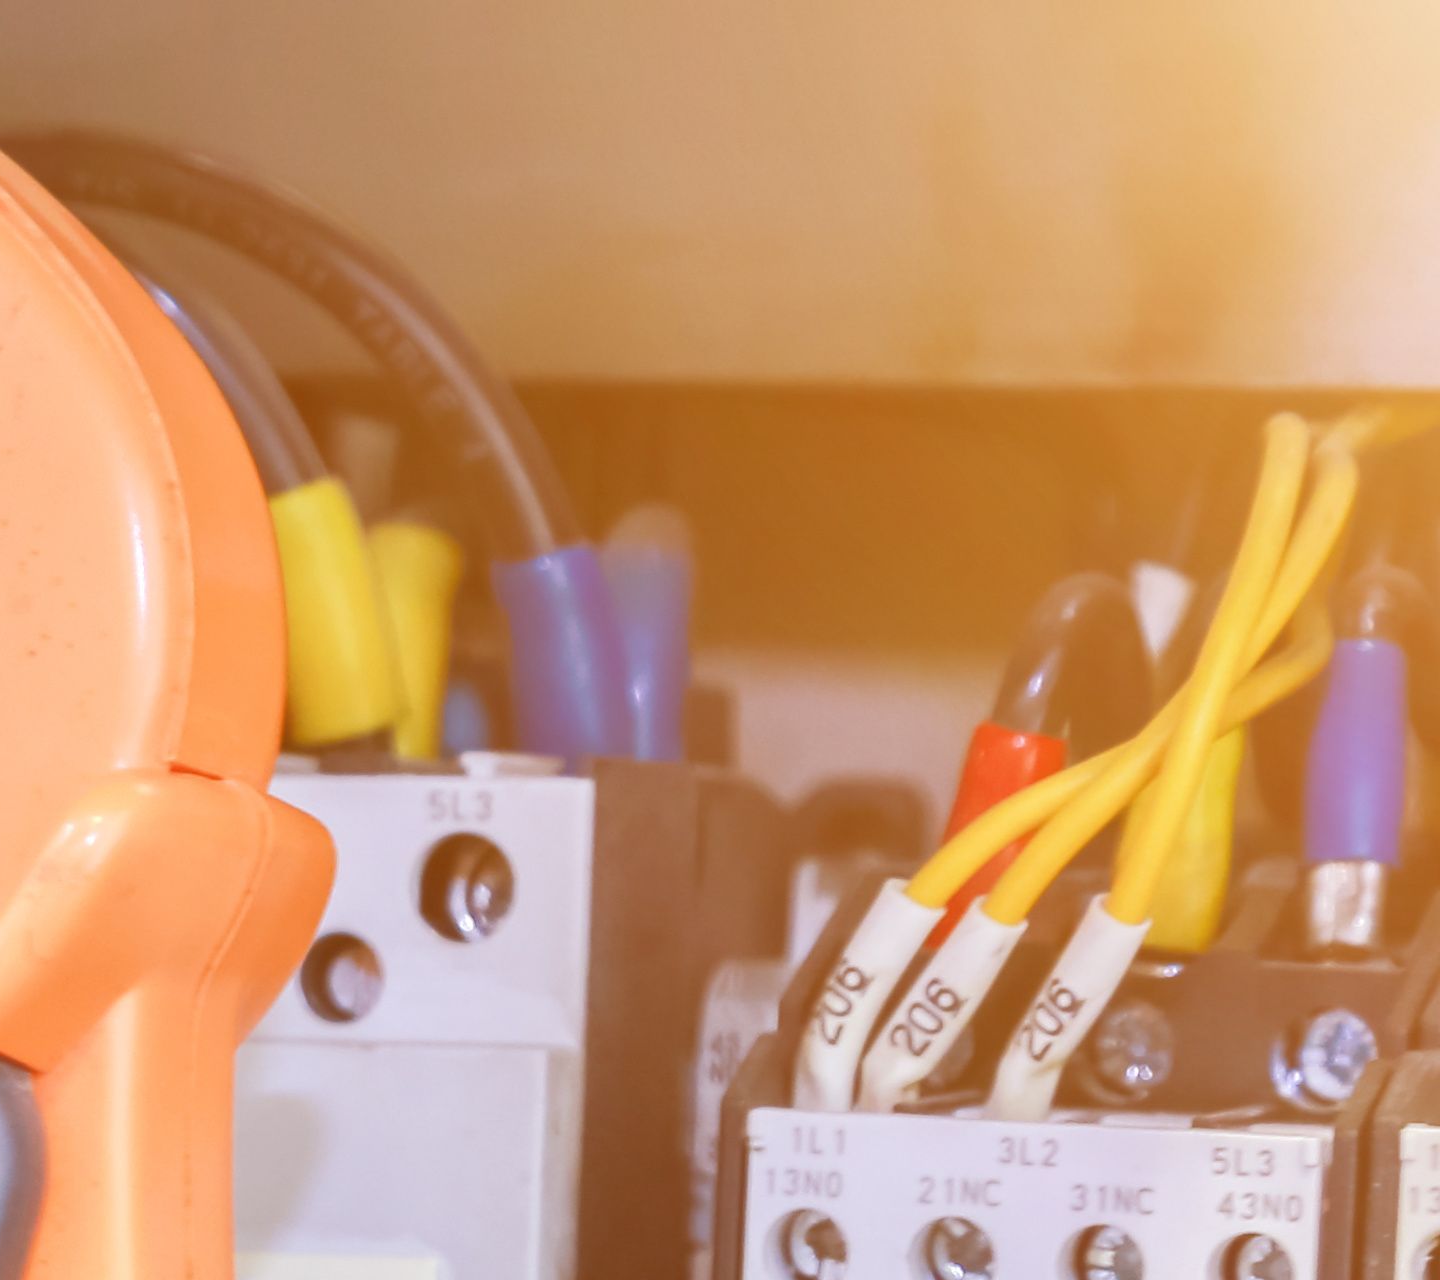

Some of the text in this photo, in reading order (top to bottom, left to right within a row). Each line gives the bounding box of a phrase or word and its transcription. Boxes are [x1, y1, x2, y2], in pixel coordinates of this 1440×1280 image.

[425, 788, 494, 822] 5L3
[890, 976, 963, 1059] 206
[1019, 978, 1082, 1062] 206
[792, 1125, 847, 1157] 1L1
[999, 1136, 1059, 1168] 3L2
[1210, 1147, 1275, 1178] 5L3
[917, 1177, 1002, 1208] 21NC
[1069, 1185, 1156, 1217] 31NC
